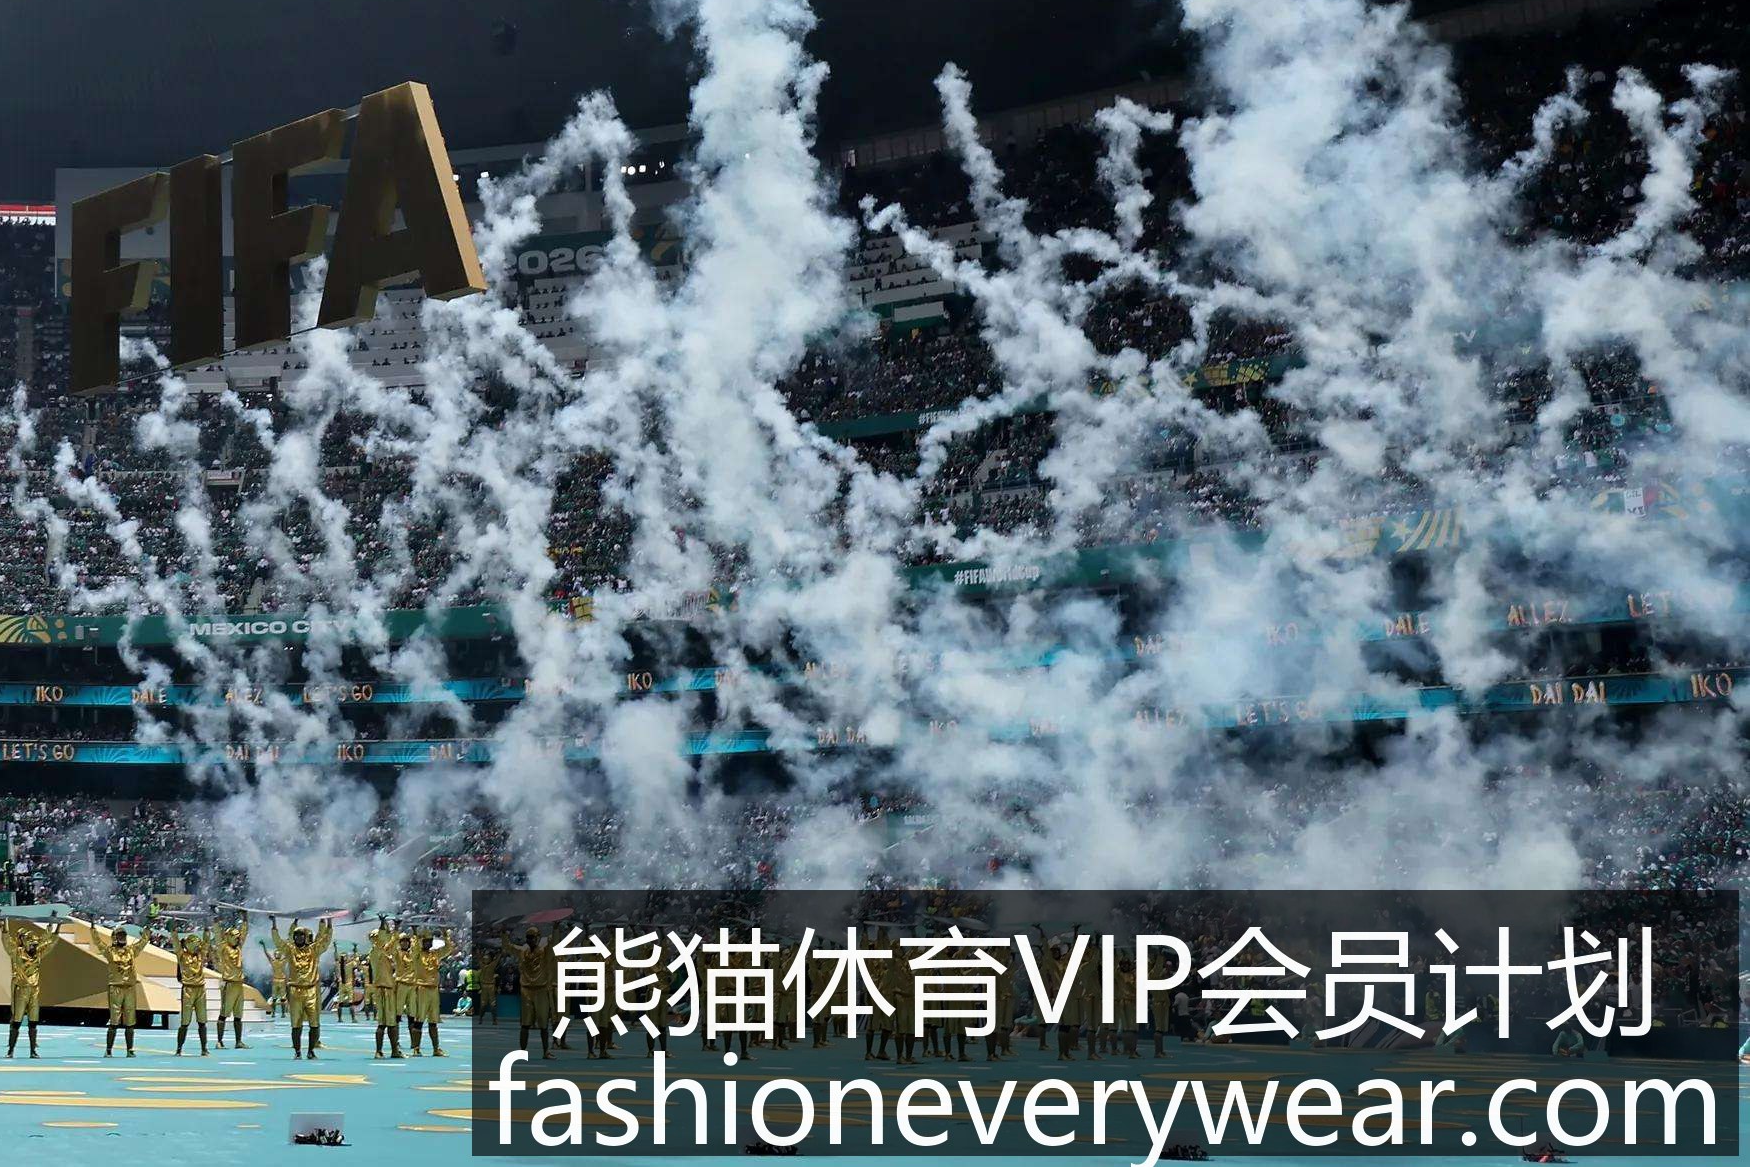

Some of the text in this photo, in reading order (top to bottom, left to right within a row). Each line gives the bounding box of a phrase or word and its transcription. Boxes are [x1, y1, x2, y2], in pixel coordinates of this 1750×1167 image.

[70, 80, 488, 398] FIFA
[1384, 611, 1430, 636] DALE
[1507, 601, 1574, 627] ALLEZ
[189, 620, 287, 636] MEXICO
[627, 672, 653, 691] IKO
[1690, 671, 1733, 700] IKO
[35, 685, 64, 703] IKO
[131, 688, 167, 705] DALE
[351, 684, 373, 702] GO
[1529, 680, 1608, 707] DAI DAI
[2, 742, 75, 761] LET'S GO
[338, 743, 364, 762] IKO
